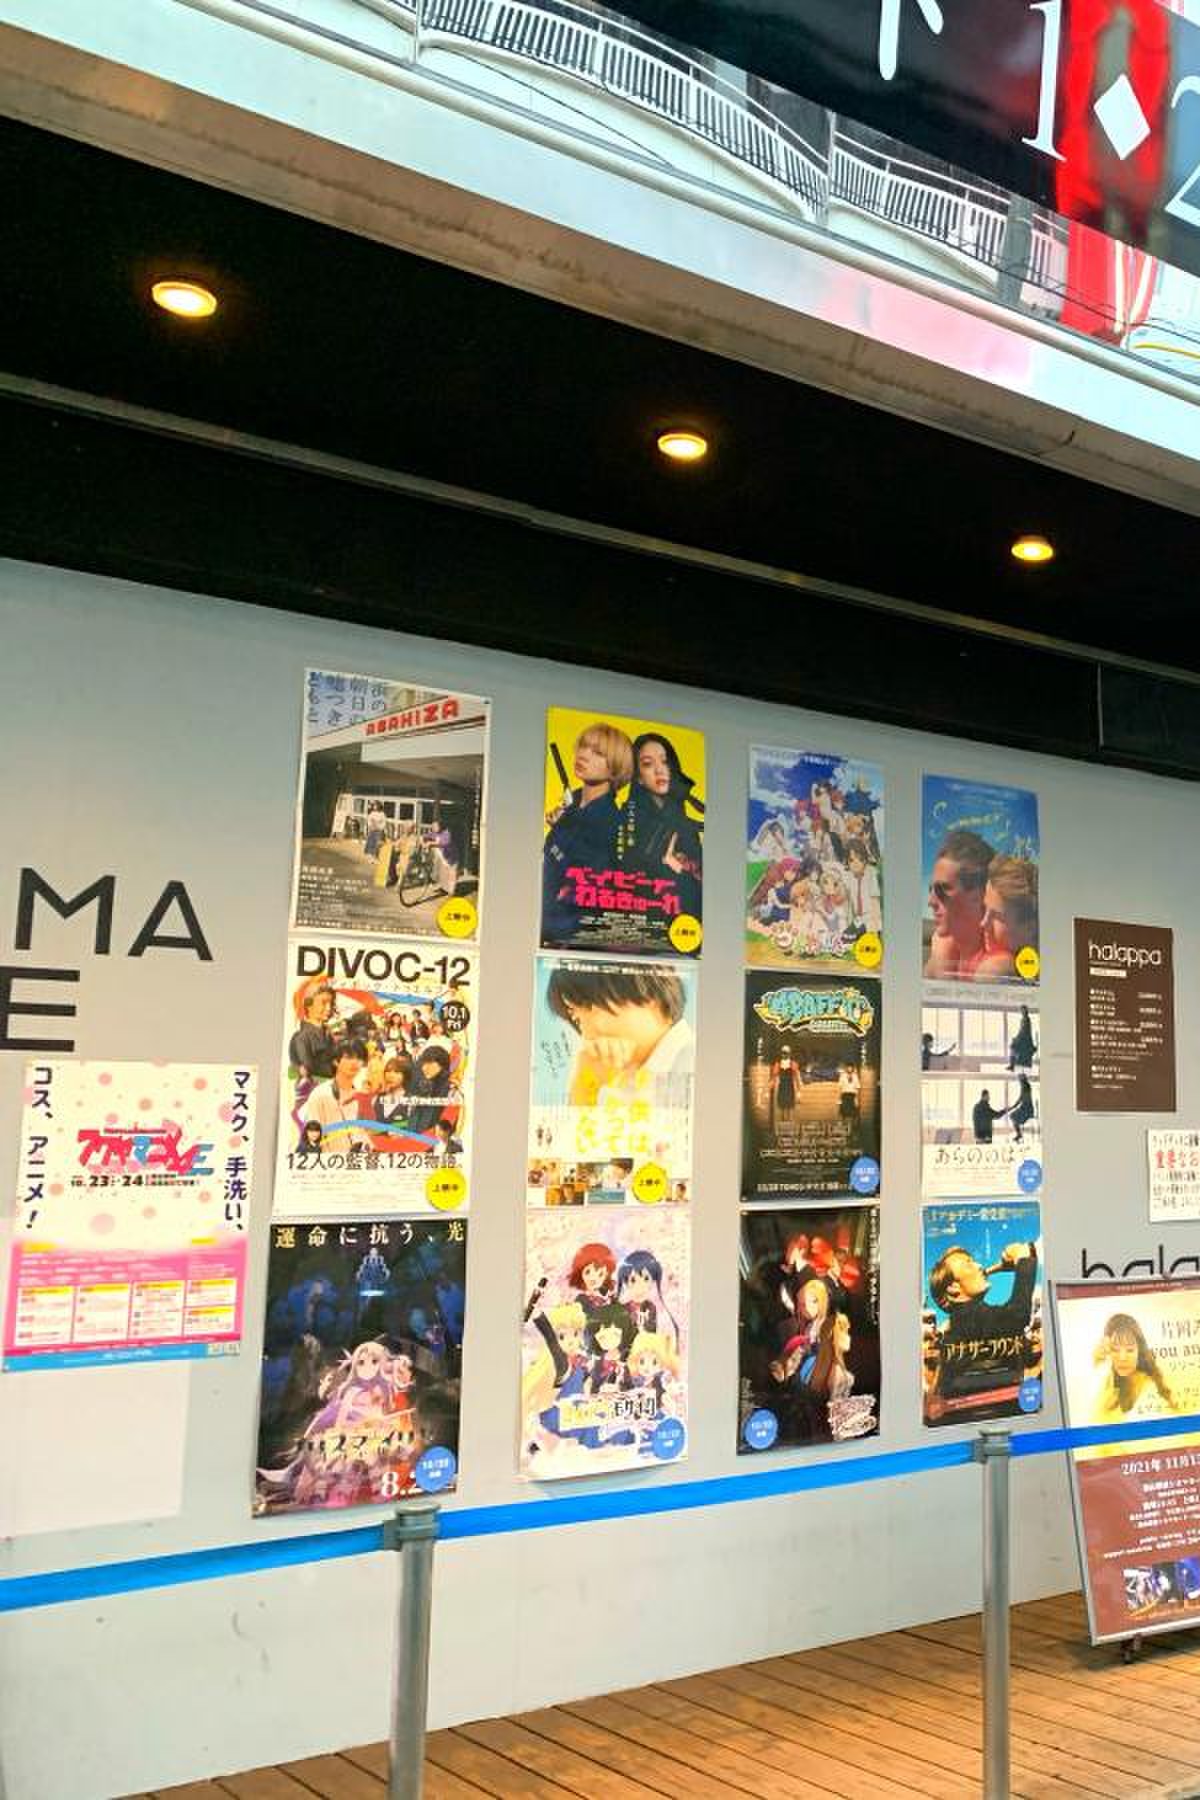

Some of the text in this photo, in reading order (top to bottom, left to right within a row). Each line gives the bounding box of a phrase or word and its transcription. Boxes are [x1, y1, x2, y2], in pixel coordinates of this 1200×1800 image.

[365, 697, 460, 737] ASAHIZA
[14, 867, 214, 961] MA
[296, 945, 471, 987] DIVOC-12
[1087, 940, 1163, 968] halappa
[0, 965, 81, 1052] E
